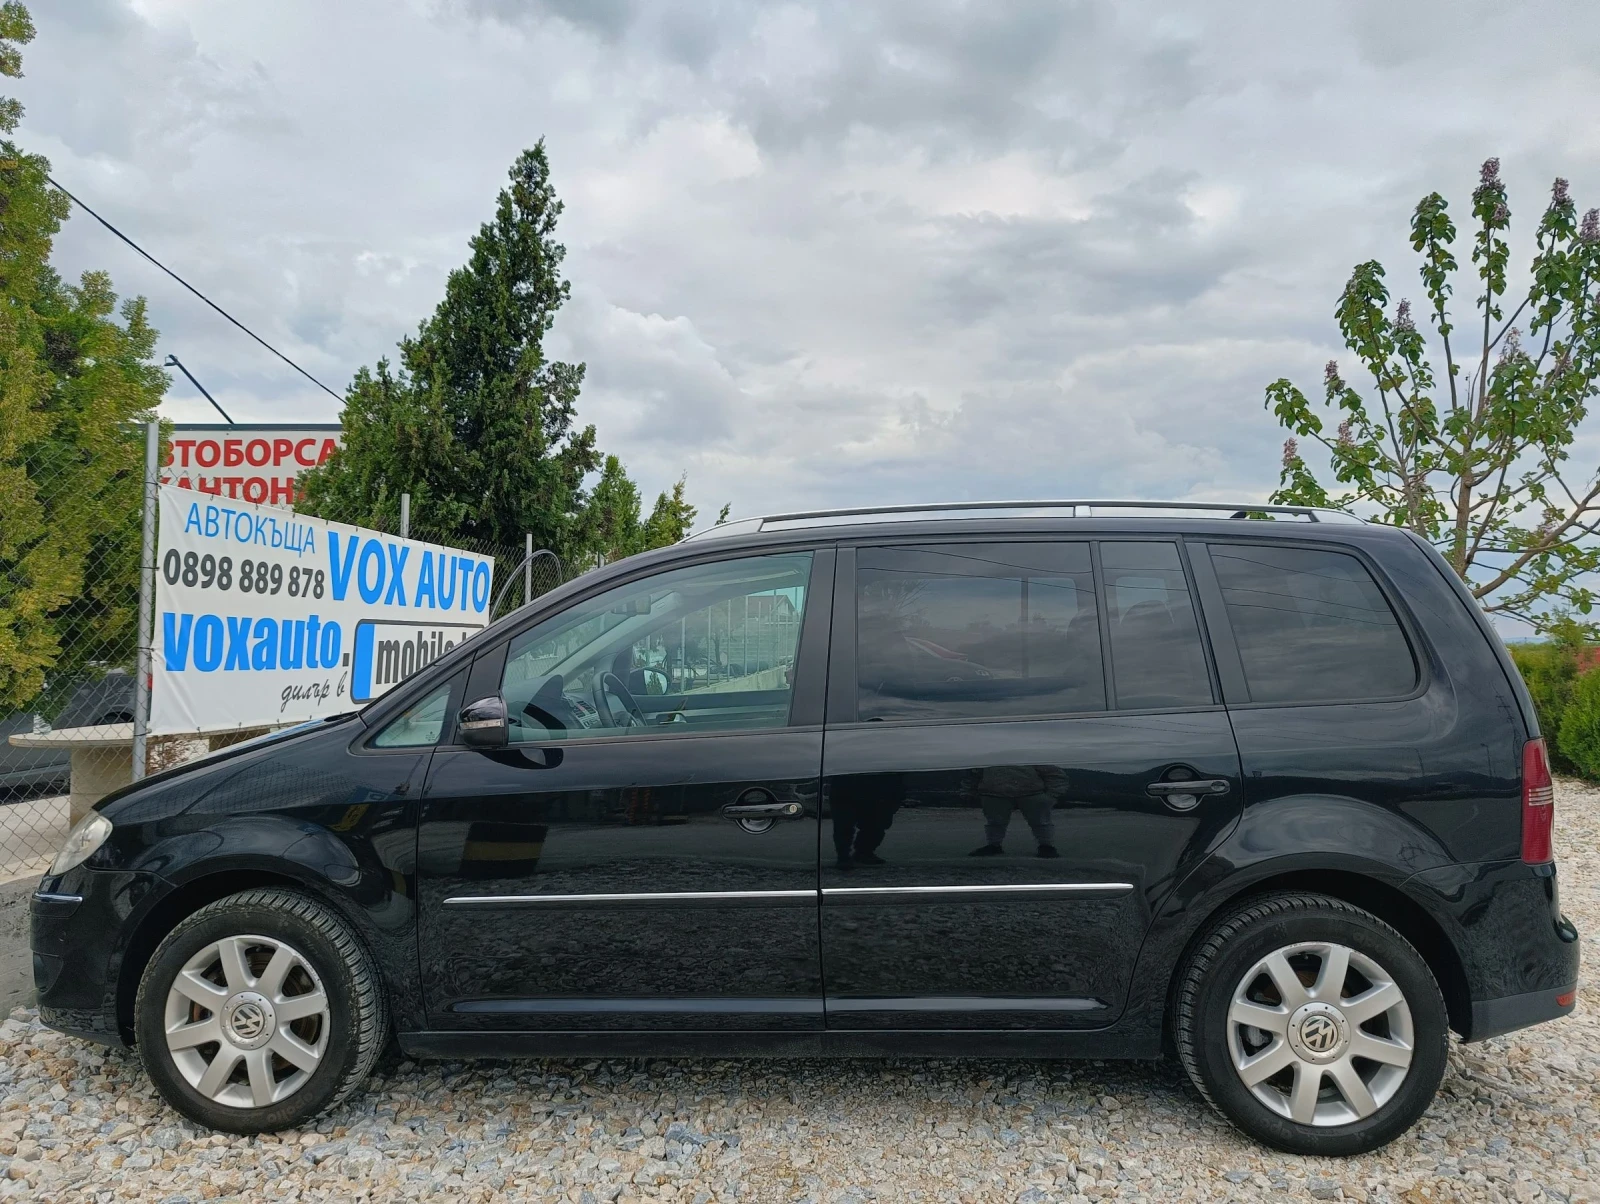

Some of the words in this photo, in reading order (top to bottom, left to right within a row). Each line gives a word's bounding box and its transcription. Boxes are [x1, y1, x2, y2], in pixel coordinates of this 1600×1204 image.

[160, 438, 337, 468] ВТОБОРСА
[185, 502, 315, 558] АВТОКЪЩА
[163, 548, 233, 591] 0898
[239, 559, 283, 595] 889
[287, 566, 325, 599] 878
[327, 530, 410, 606] VOX
[414, 550, 490, 613] AUTO
